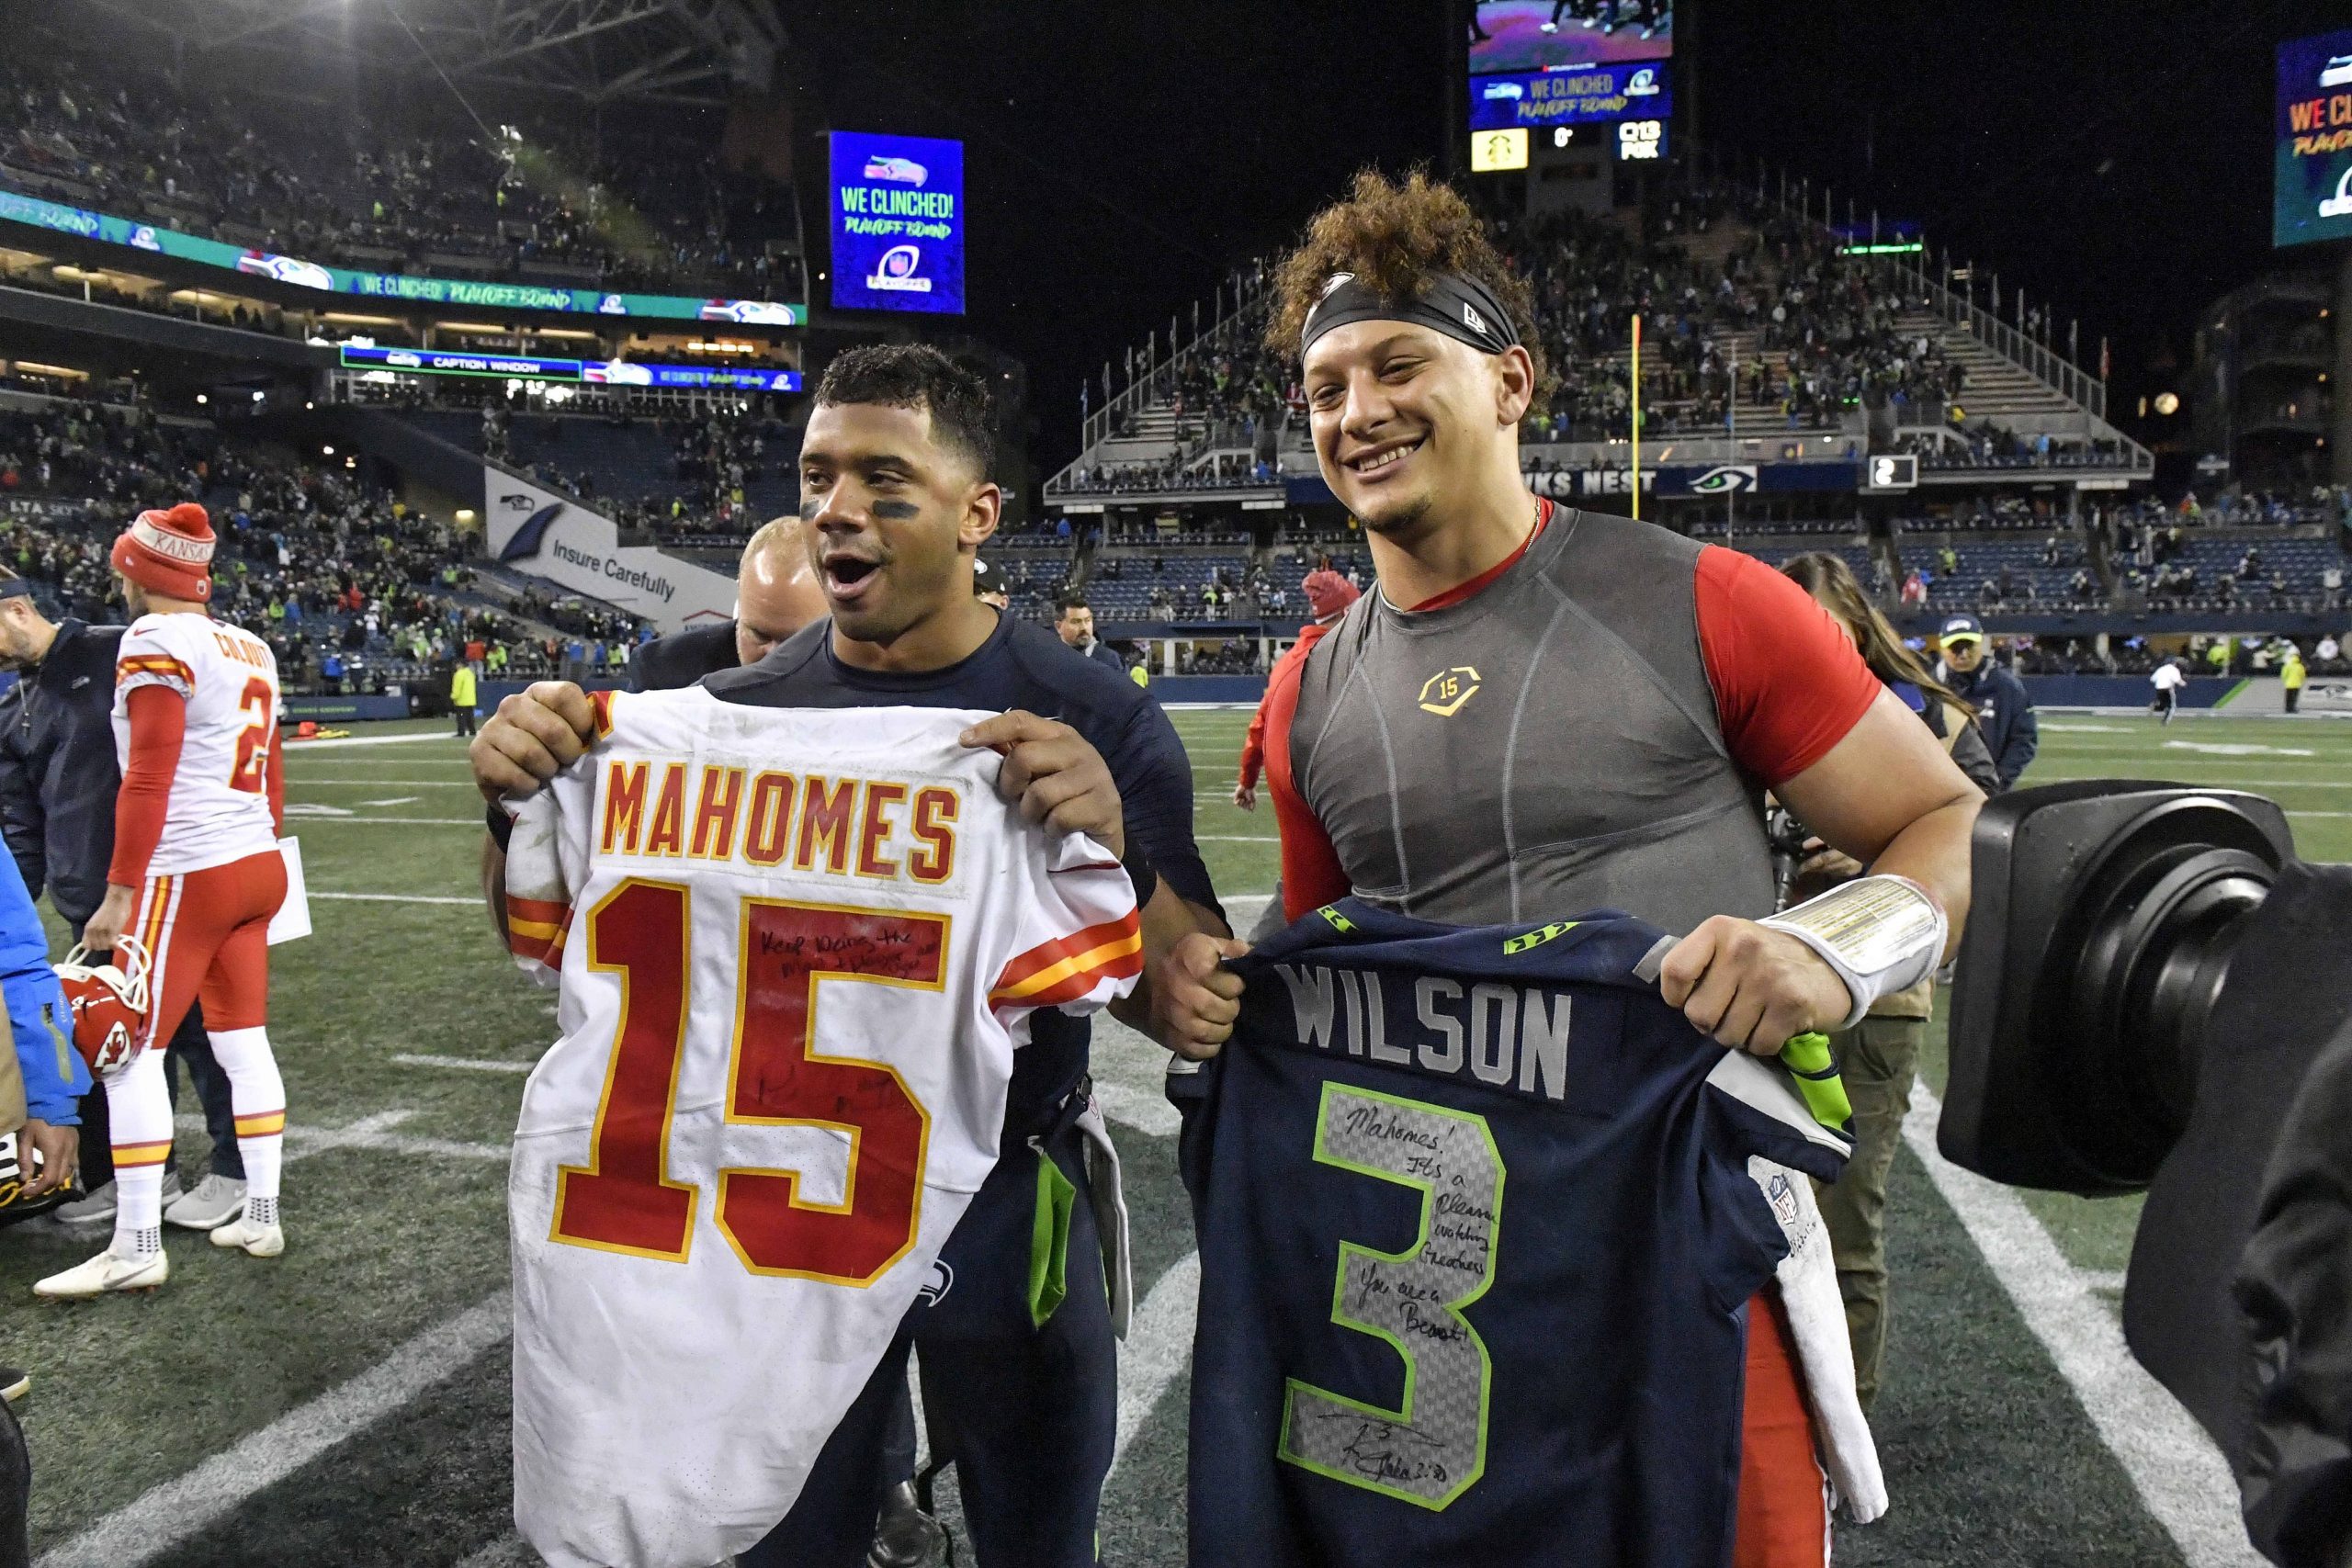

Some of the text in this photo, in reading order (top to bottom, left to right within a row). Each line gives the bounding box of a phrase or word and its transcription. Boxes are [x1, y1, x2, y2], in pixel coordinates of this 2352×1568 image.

[1530, 80, 1550, 98] WE
[1619, 120, 1661, 141] Q13
[2290, 98, 2325, 132] WE
[1621, 141, 1658, 160] FOX
[842, 186, 954, 219] WE CLINCHED!
[844, 217, 952, 240] PLAYOFF BOUND
[365, 276, 382, 294] WE
[449, 283, 516, 304] PLAYOFF
[433, 356, 540, 373] CAPTION WINDOW
[1583, 470, 1657, 494] NEST
[154, 532, 211, 558] KANSAS
[553, 538, 676, 603] Insure Carefully
[1440, 676, 1458, 700] 15
[229, 675, 273, 794] 2
[600, 760, 959, 885] MAHOMES
[1273, 964, 1572, 1100] WILSON
[548, 875, 953, 1289] 15
[1347, 1106, 1455, 1155] Mahomes!
[1452, 1174, 1467, 1188] a
[1775, 1191, 1796, 1222] NFL
[1277, 1080, 1507, 1513] 3
[1359, 1262, 1389, 1310] You
